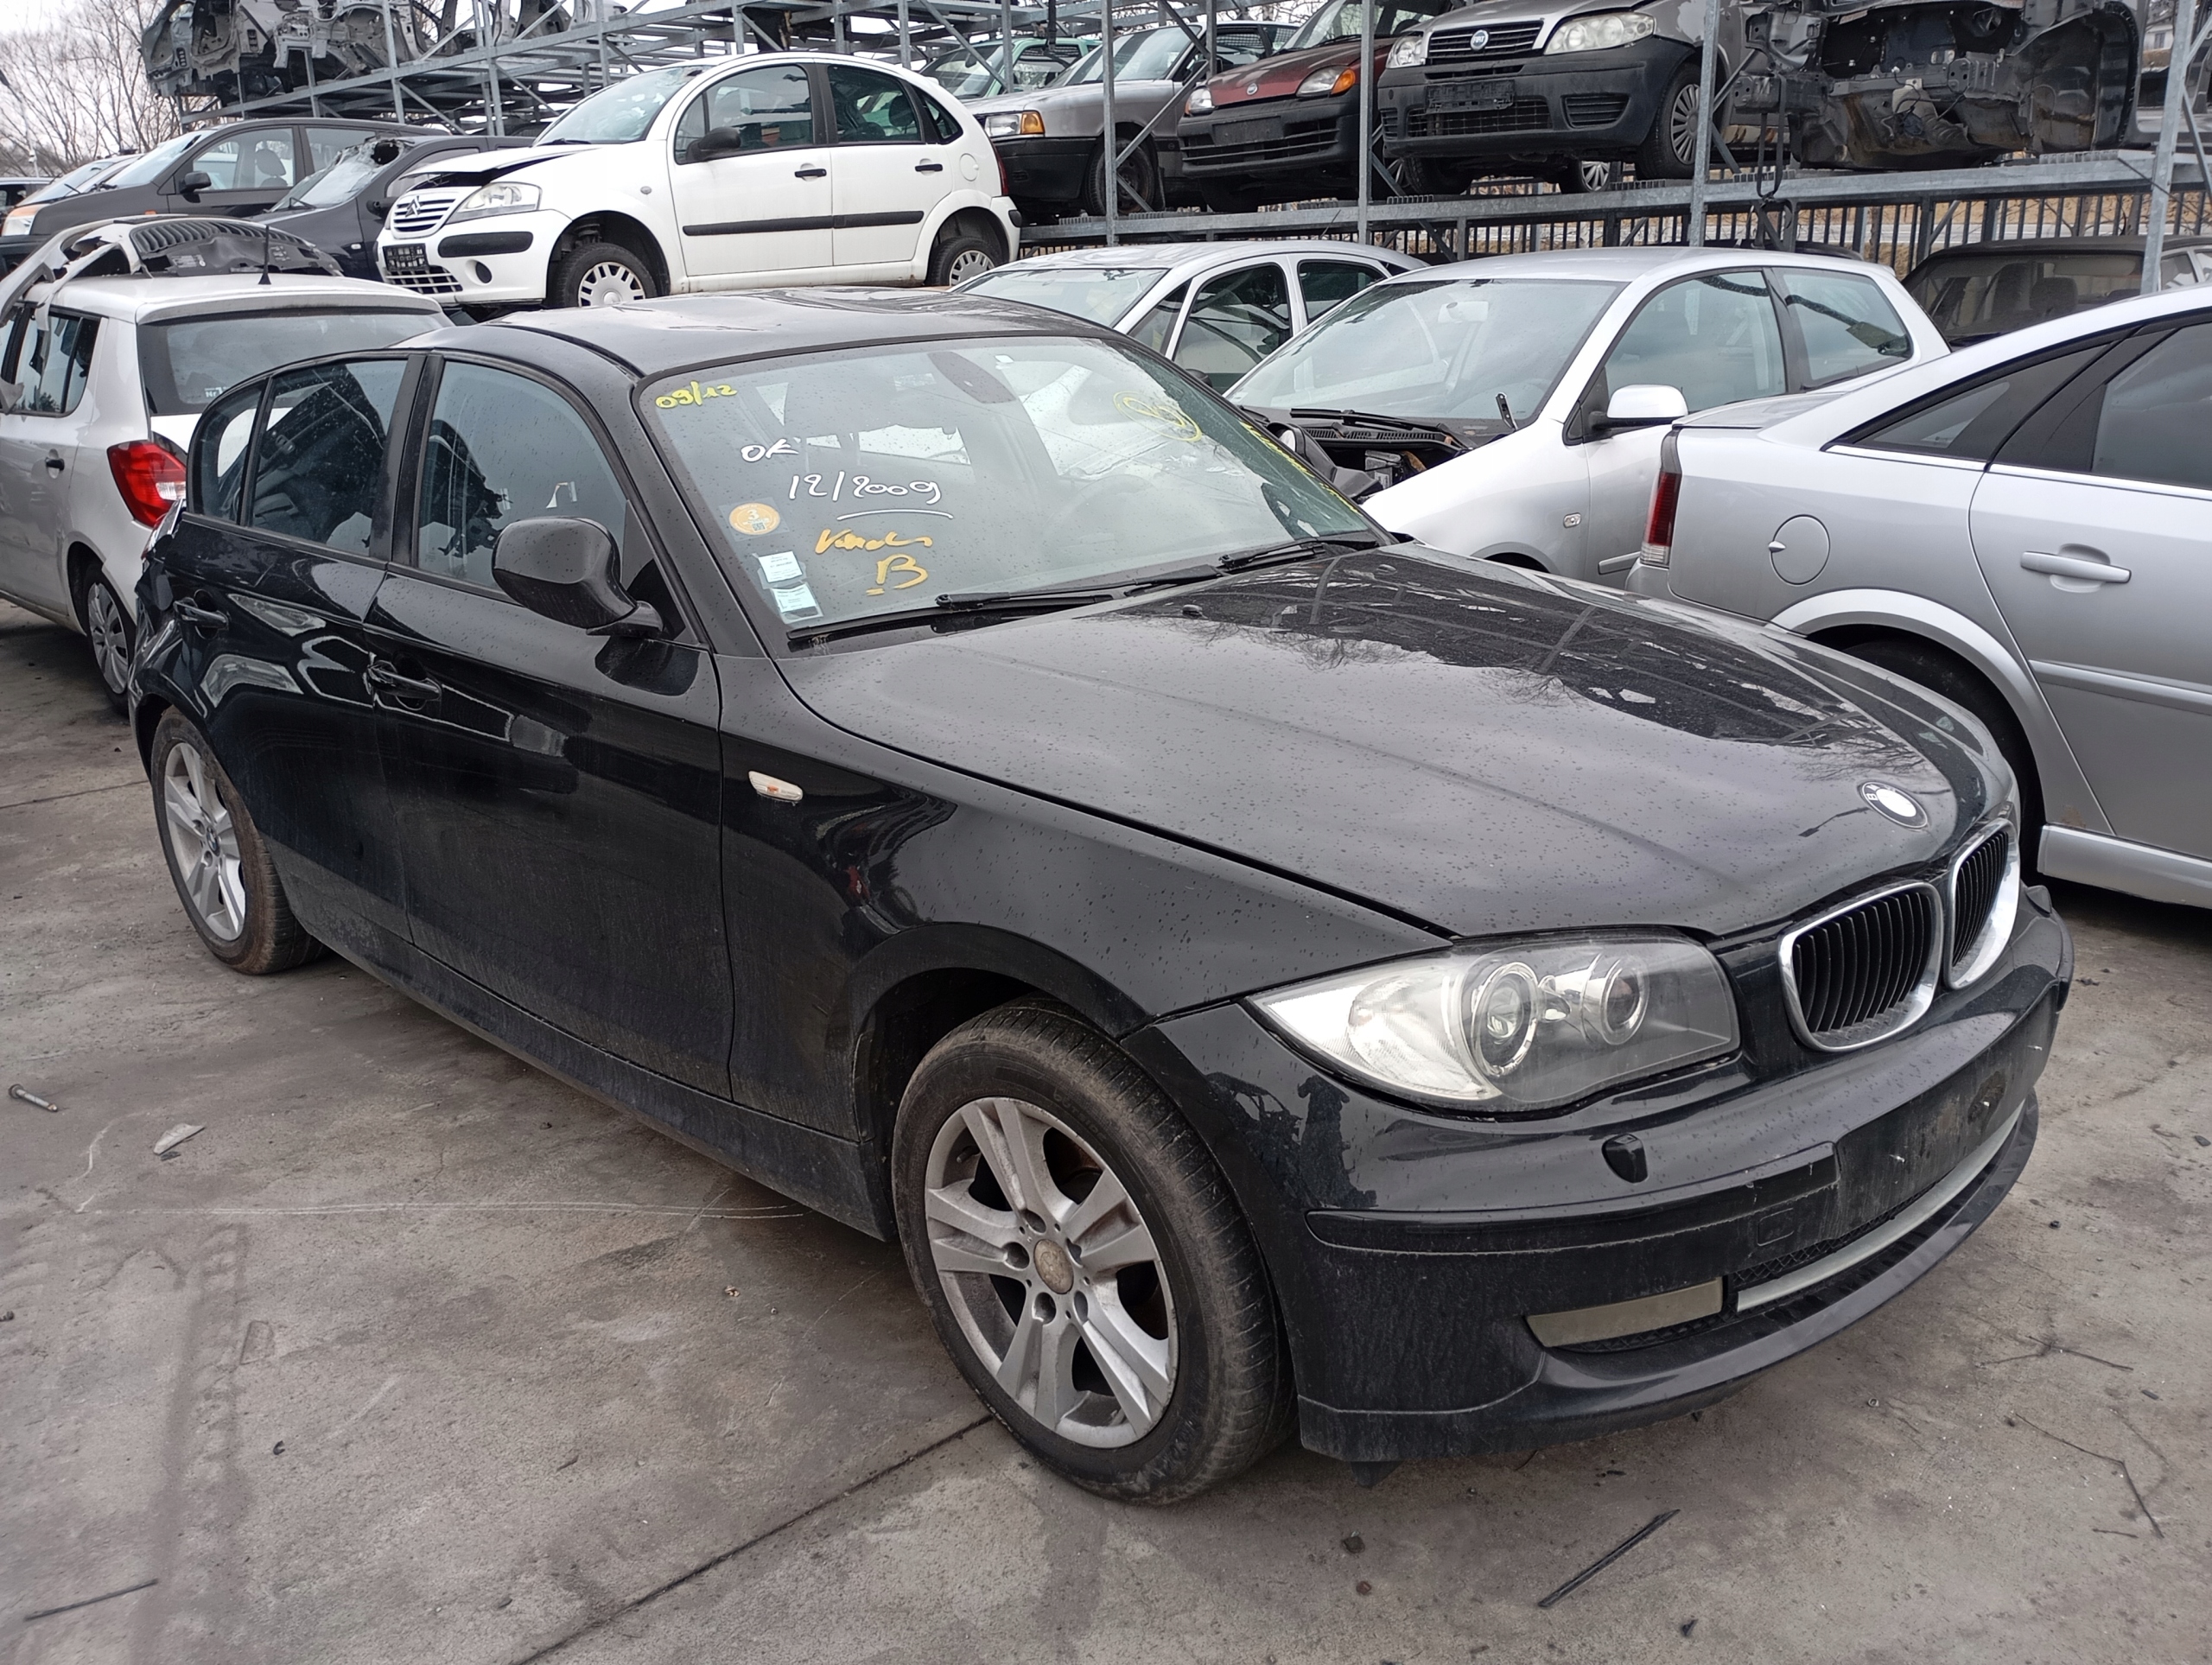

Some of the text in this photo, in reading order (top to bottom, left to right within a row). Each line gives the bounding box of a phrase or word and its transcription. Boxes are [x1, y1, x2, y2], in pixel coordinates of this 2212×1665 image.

[655, 380, 738, 409] 09/12
[788, 470, 942, 505] 12/2009
[747, 509, 760, 520] 3
